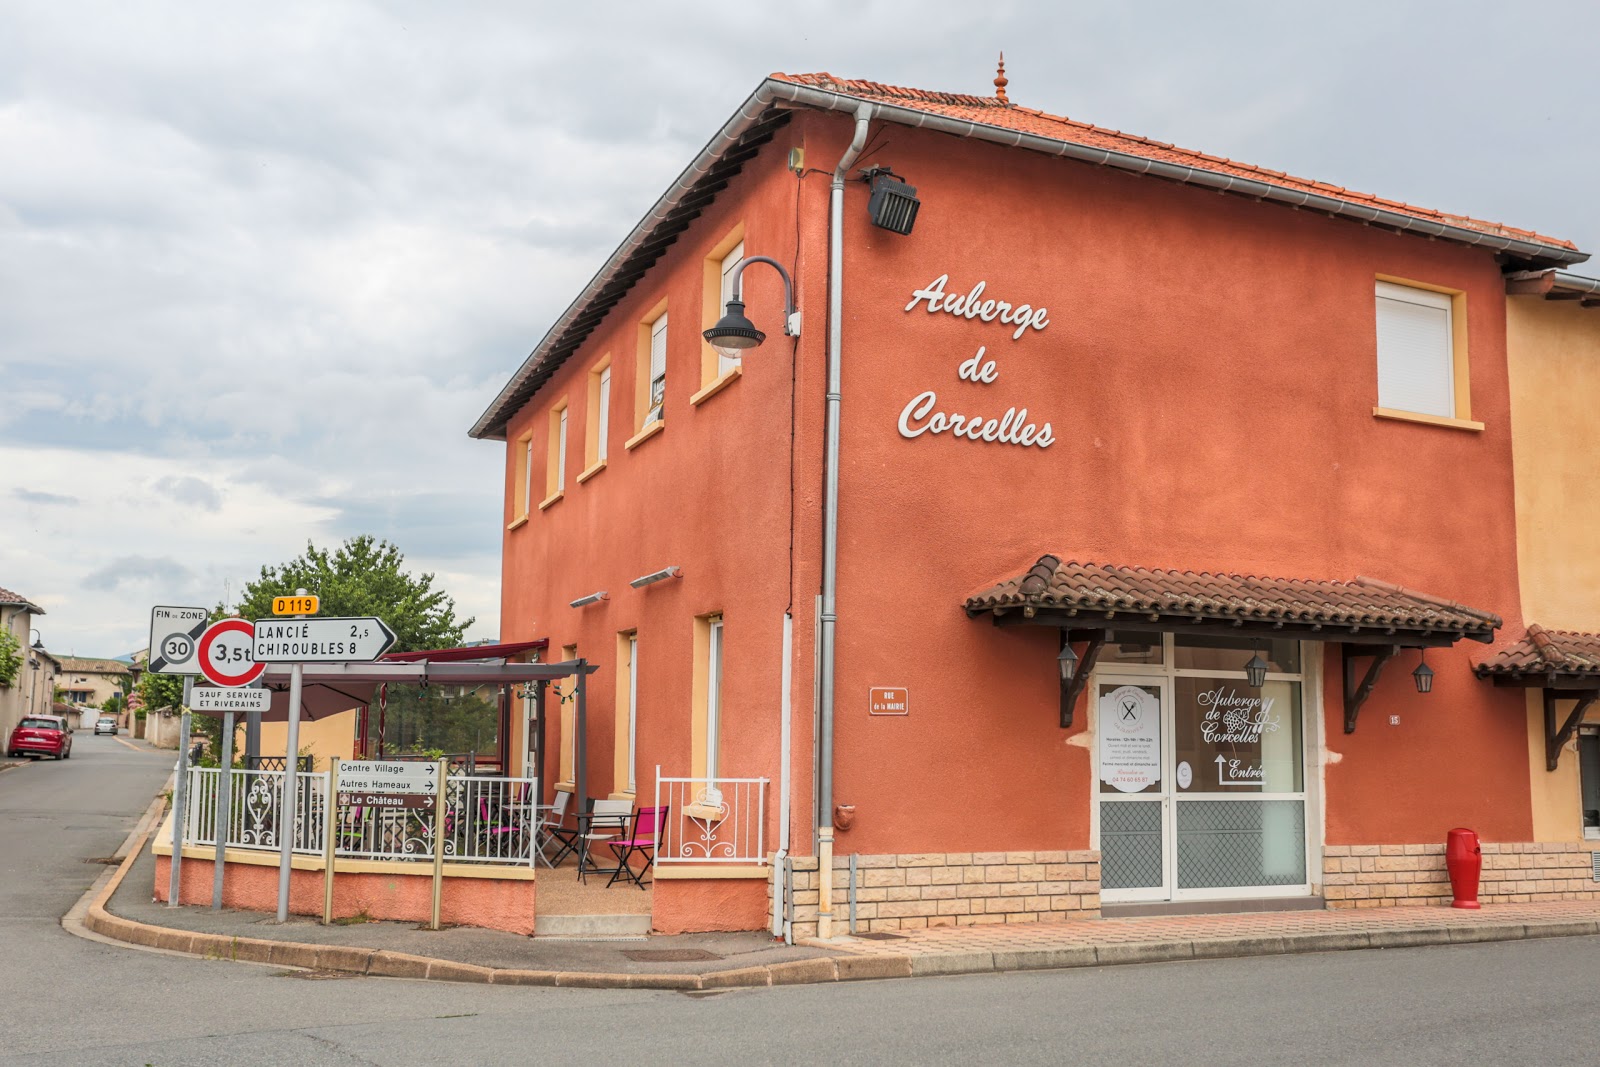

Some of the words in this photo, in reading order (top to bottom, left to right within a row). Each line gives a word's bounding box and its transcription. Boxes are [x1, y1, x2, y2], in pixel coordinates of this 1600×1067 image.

[904, 273, 1050, 340] Auberge
[958, 346, 999, 384] de
[897, 390, 1056, 448] Corcelles
[278, 600, 285, 612] D
[289, 599, 312, 612] 119
[156, 610, 170, 618] FIN
[180, 611, 204, 620] ZONE
[258, 623, 309, 639] LANCIÉ
[350, 625, 369, 639] 2,5
[167, 641, 188, 655] 30
[258, 642, 344, 655] CHIROUBLES
[349, 642, 357, 654] 8
[226, 691, 263, 699] SERVICE
[883, 691, 895, 700] RUE
[1197, 685, 1262, 709] Auberge
[214, 700, 261, 708] RIVERAINS
[1205, 707, 1221, 721] de
[1391, 716, 1399, 724] 15
[1200, 720, 1259, 744] Corcelles
[340, 763, 370, 772] Centre
[374, 764, 404, 774] Village
[1228, 758, 1267, 779] Entrée
[340, 779, 368, 788] Autres
[371, 780, 411, 789] Hameaux
[351, 796, 363, 804] Le
[366, 795, 404, 806] Château
